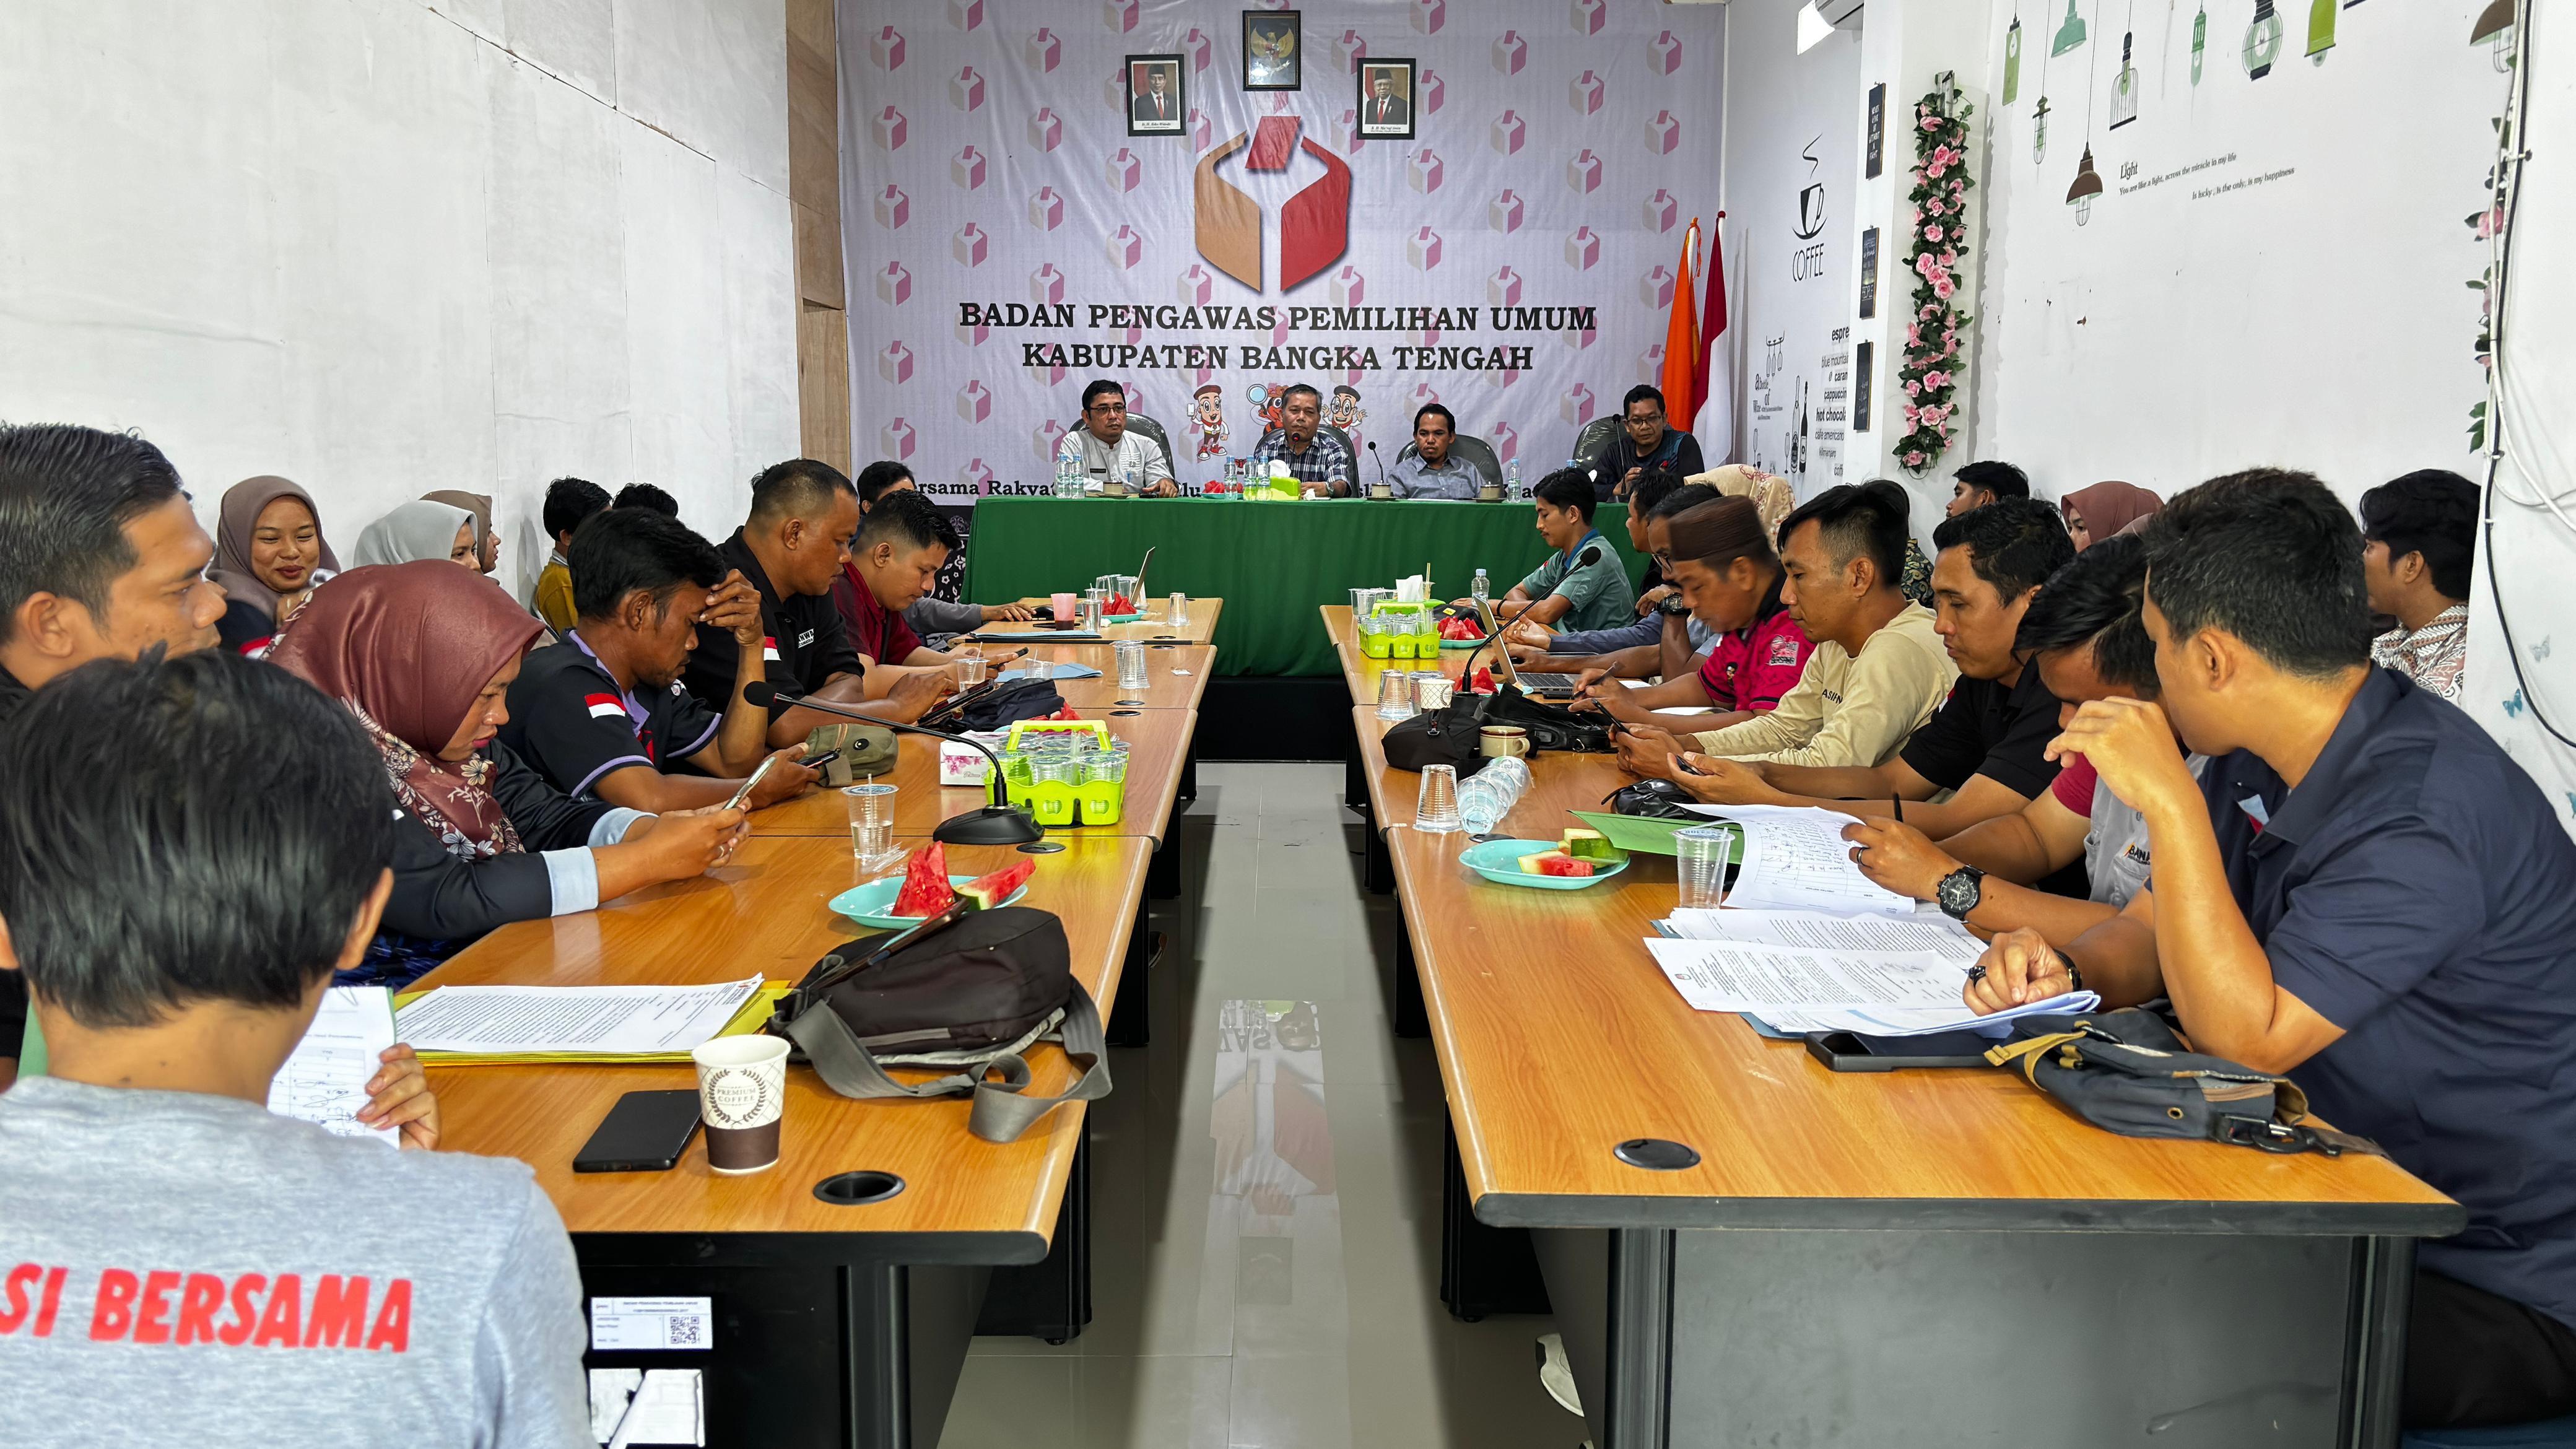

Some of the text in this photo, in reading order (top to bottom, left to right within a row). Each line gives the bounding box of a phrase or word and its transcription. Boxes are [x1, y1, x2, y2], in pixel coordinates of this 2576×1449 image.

[2120, 161, 2138, 180] Light
[2120, 187, 2129, 196] You
[2130, 185, 2138, 193] are
[2138, 180, 2147, 190] like
[2165, 170, 2181, 181] across
[2182, 166, 2191, 175] the
[2191, 159, 2211, 173] miracle
[2218, 155, 2227, 165] my
[2227, 152, 2237, 162] life
[2222, 182, 2232, 193] the
[2254, 175, 2263, 185] my
[2264, 167, 2295, 181] happiness
[1793, 242, 1824, 282] COFFEE
[959, 302, 1596, 331] BADAN PENGAWAS PEMILIHAN UMUM
[1022, 343, 1533, 371] KABUPATEN BANGKA TENGAH
[1816, 407, 1825, 422] hot
[89, 1268, 412, 1353] BERSAMA
